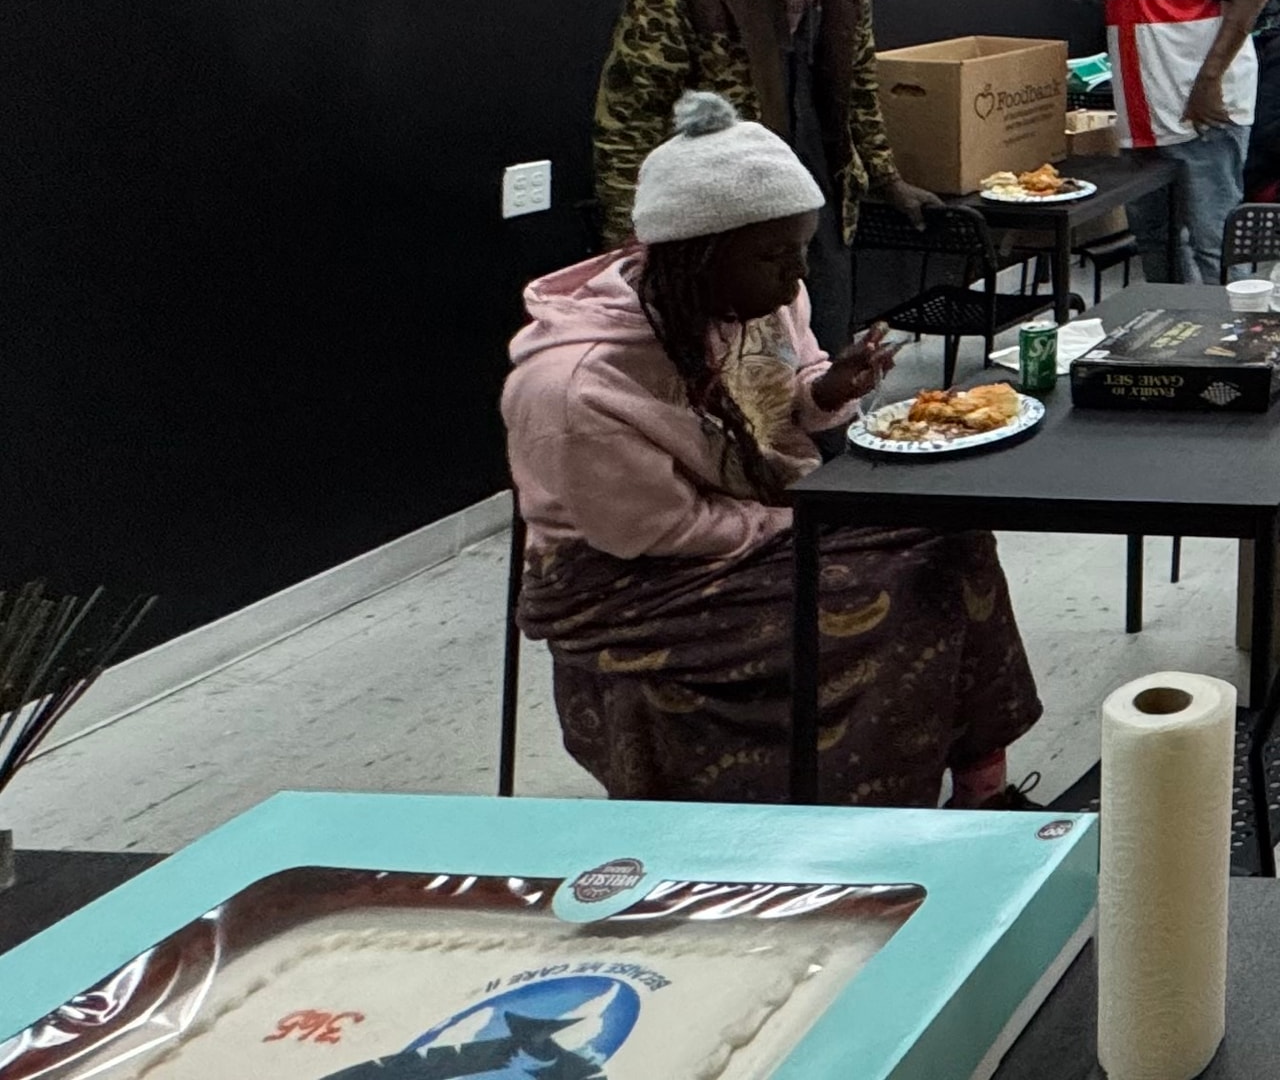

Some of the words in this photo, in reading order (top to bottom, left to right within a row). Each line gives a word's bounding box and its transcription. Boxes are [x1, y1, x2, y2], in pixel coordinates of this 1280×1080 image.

[996, 79, 1061, 110] Foodbank
[1103, 373, 1133, 385] SET
[1137, 374, 1184, 387] GAME
[1129, 386, 1175, 398] FAMILY
[507, 963, 570, 986] CARE
[605, 962, 672, 992] BECAUSE
[260, 1008, 365, 1045] 365
